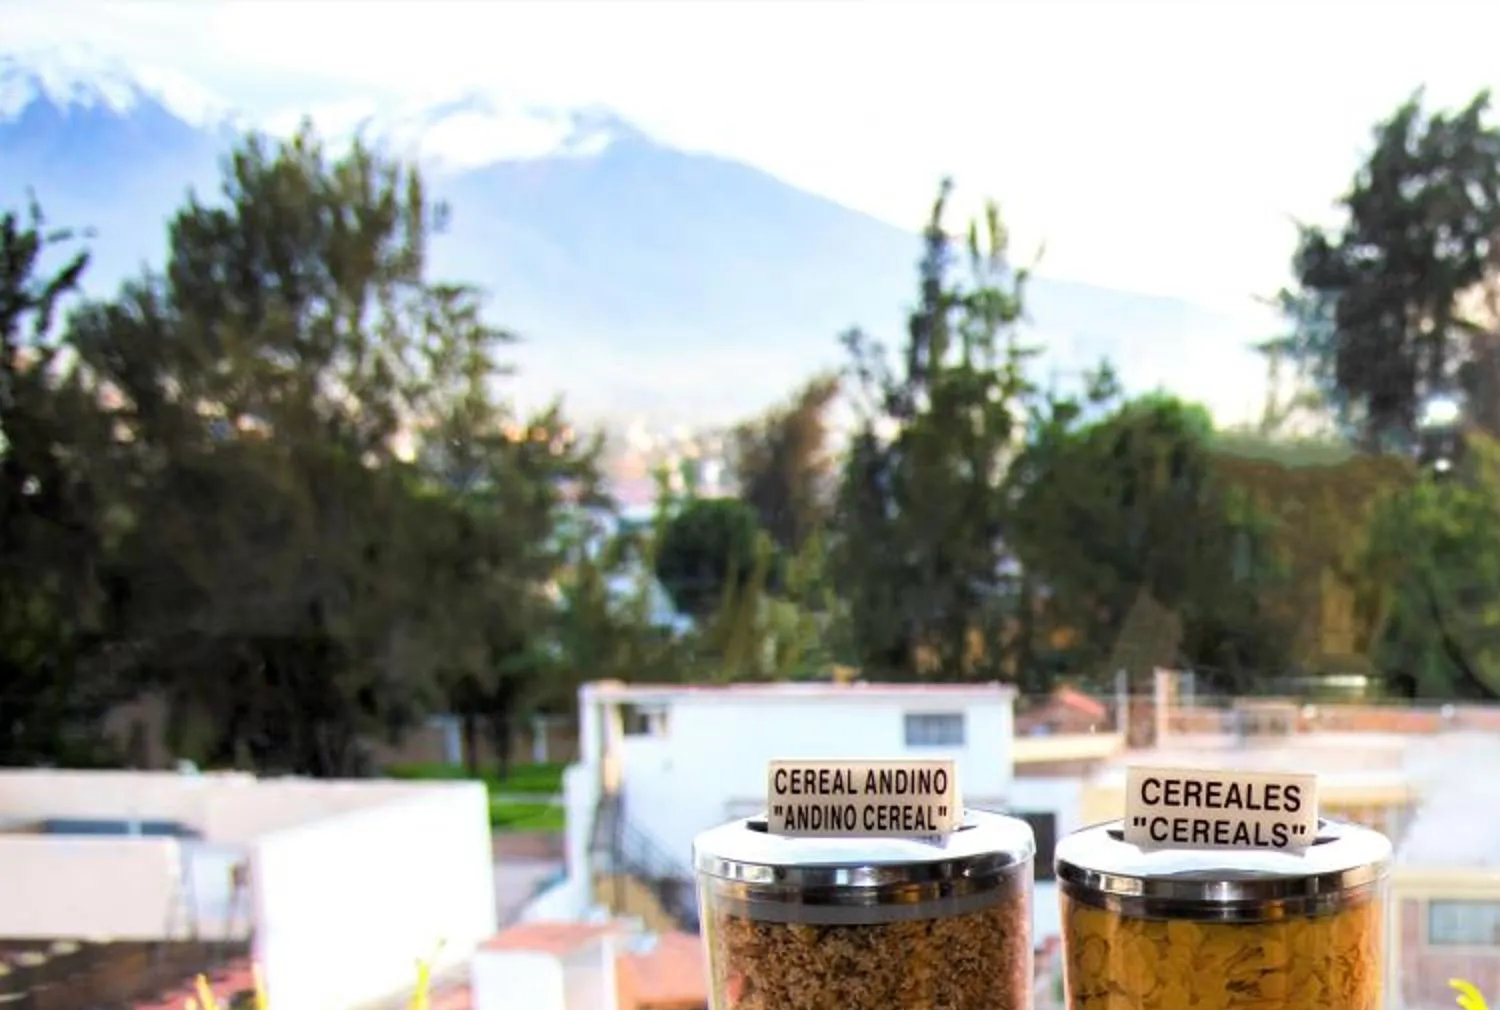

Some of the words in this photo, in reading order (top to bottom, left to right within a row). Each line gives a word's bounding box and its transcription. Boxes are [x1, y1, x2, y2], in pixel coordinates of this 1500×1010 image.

[774, 768, 857, 795] CEREAL
[864, 768, 947, 795] ANDINO
[1140, 778, 1301, 812] CEREALES
[773, 804, 857, 830] "ANDINO
[863, 804, 947, 830] CEREAL"
[1133, 816, 1306, 848] "CEREALS"
